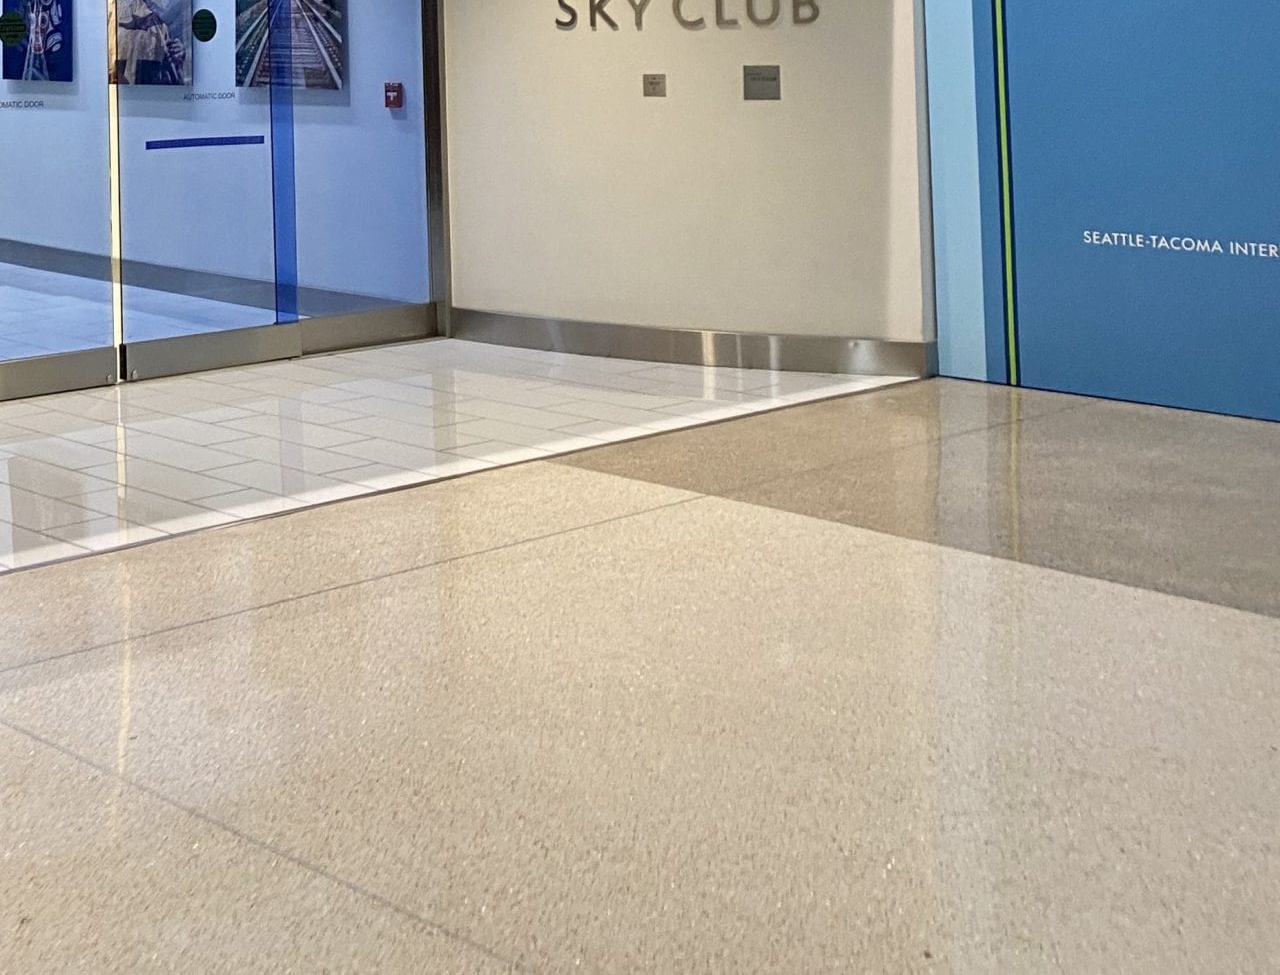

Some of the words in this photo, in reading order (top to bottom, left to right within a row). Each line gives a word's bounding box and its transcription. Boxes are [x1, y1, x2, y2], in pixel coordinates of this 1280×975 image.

[183, 93, 217, 101] AUTOMATIC
[217, 92, 236, 100] DOOR
[23, 100, 44, 109] DOOR
[1083, 230, 1223, 253] SEATTLE-TACOMA
[1229, 241, 1280, 258] INTER
